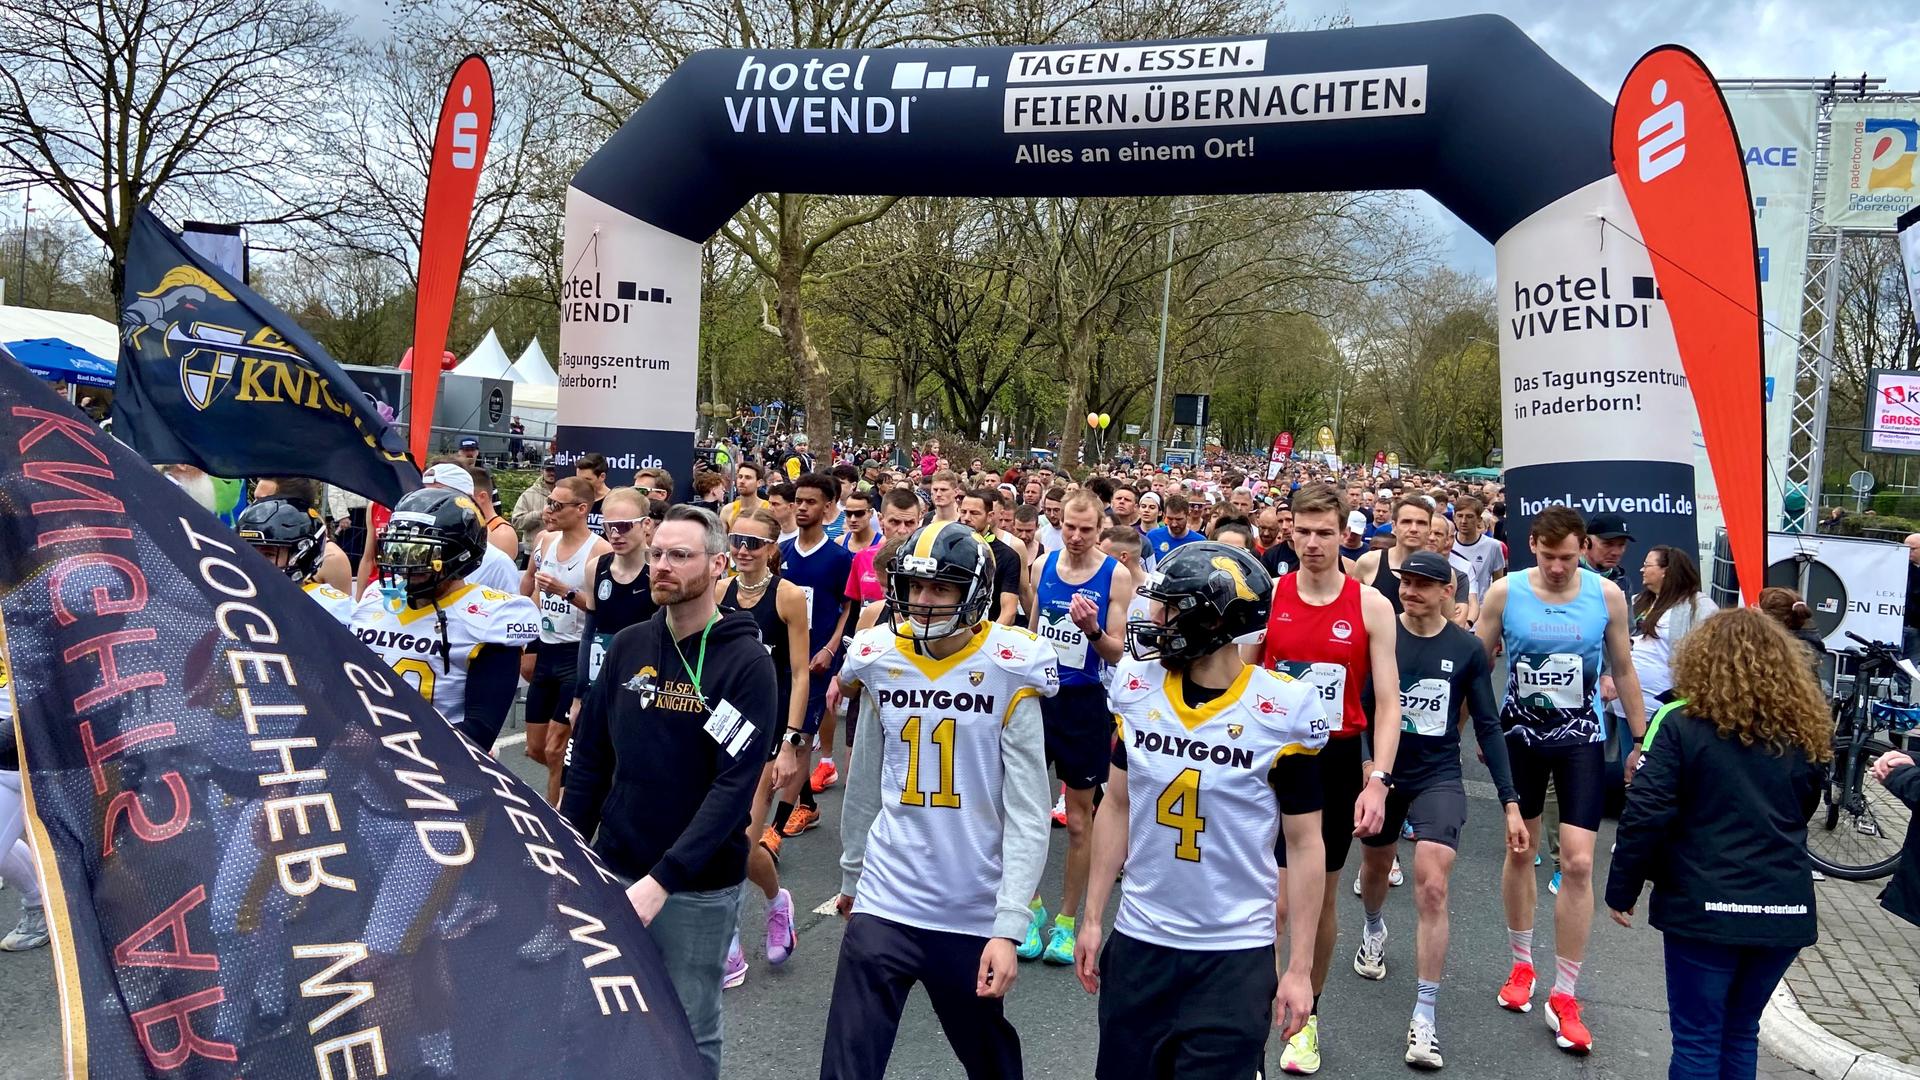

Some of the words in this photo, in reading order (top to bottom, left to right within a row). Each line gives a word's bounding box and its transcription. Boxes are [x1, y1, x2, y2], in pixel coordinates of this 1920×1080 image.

[737, 55, 866, 92] hotel
[724, 94, 912, 135] VIVENDI
[1015, 143, 1074, 165] Alles
[1081, 145, 1111, 163] an
[1118, 142, 1196, 162] einem
[1204, 137, 1256, 160] Ort!
[1745, 147, 1798, 166] ACE
[1850, 121, 1864, 189] paderborn.de
[1850, 193, 1914, 203] Paderborn
[563, 272, 602, 299] otel
[1514, 267, 1611, 312] hotel
[561, 302, 630, 323] IVENDI
[1511, 303, 1649, 340] VIVENDI
[563, 352, 671, 371] Tagungszentrum
[1514, 375, 1539, 393] Das
[1542, 368, 1688, 390] Tagungszentrum
[1514, 403, 1527, 420] in
[1532, 393, 1642, 417] Paderborn!
[1041, 625, 1081, 645] 10169
[1523, 672, 1574, 686] 11527
[655, 695, 703, 713] KNIGHTS
[878, 688, 995, 715] POLYGON
[900, 716, 961, 809] 11
[1134, 730, 1254, 769] POLYGON
[1156, 767, 1206, 863] 4
